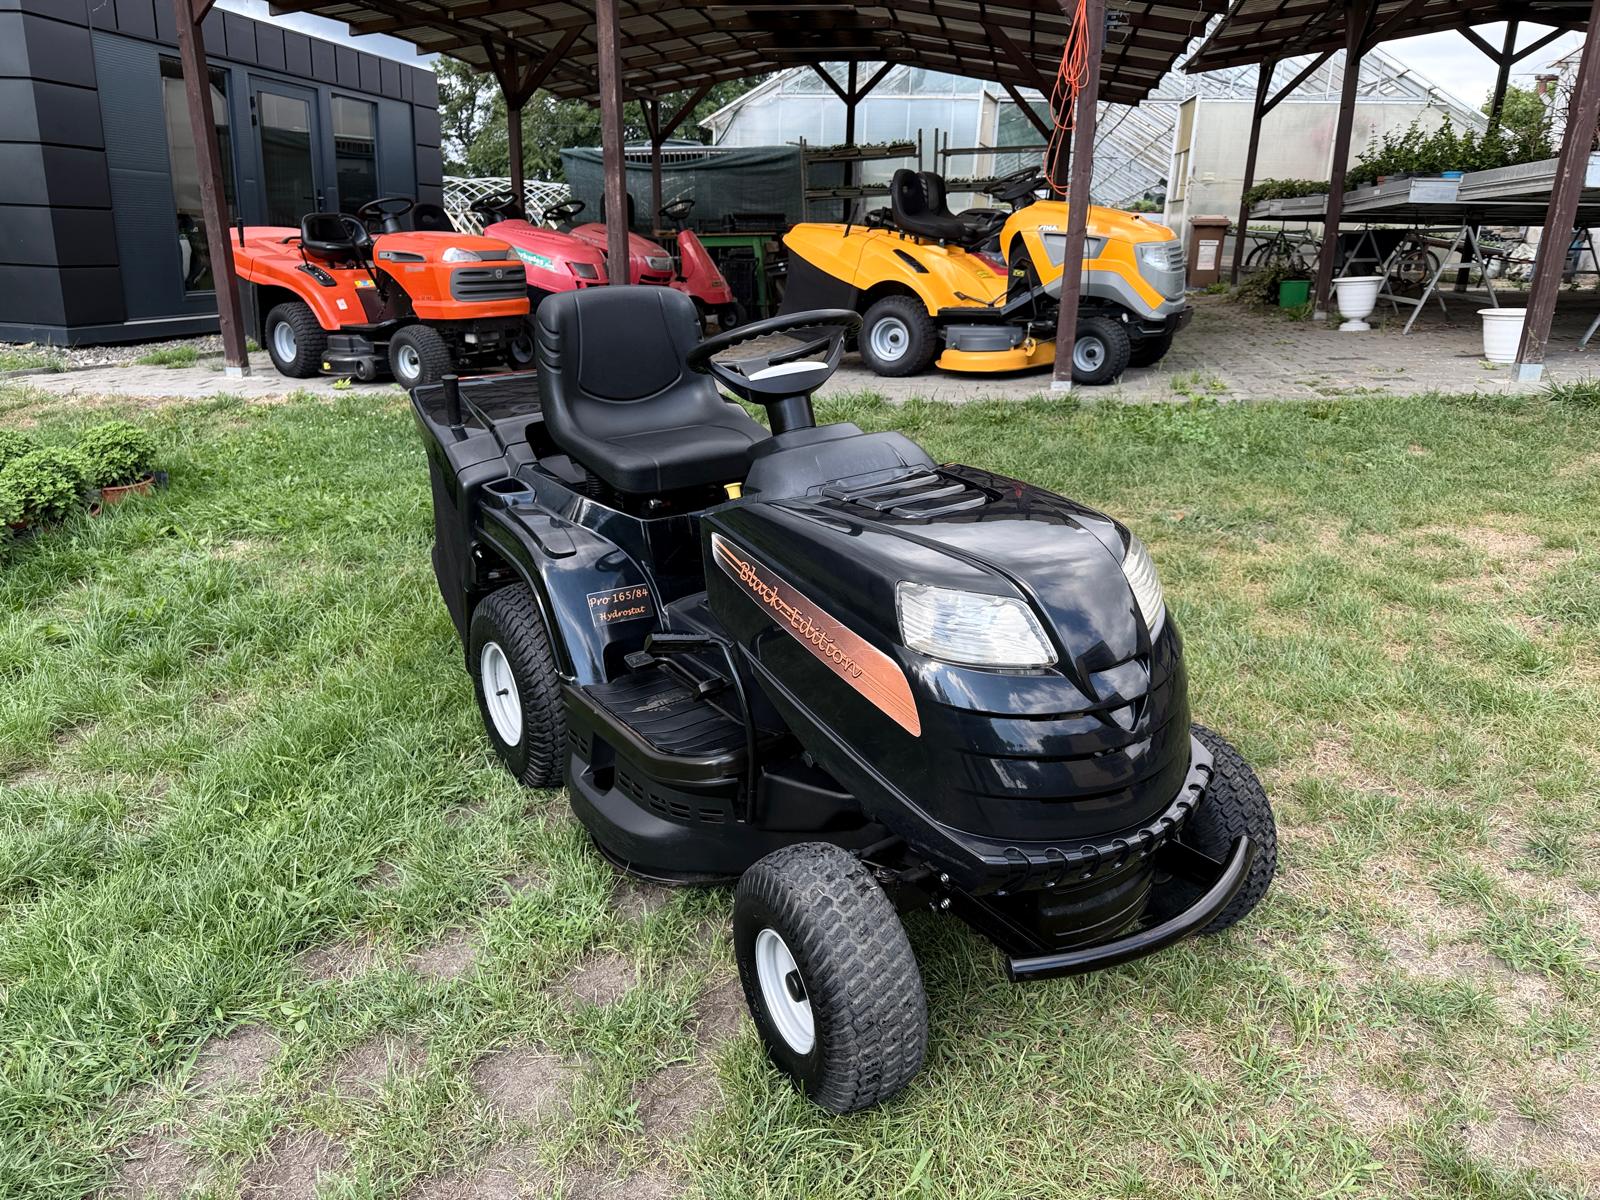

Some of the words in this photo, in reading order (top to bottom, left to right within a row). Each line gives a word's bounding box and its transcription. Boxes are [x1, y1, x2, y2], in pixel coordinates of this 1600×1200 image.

[589, 597, 611, 608] Pro
[612, 588, 649, 603] 165/84
[599, 605, 646, 622] Hydrostat
[740, 561, 782, 611] Black
[790, 607, 863, 678] Edition
